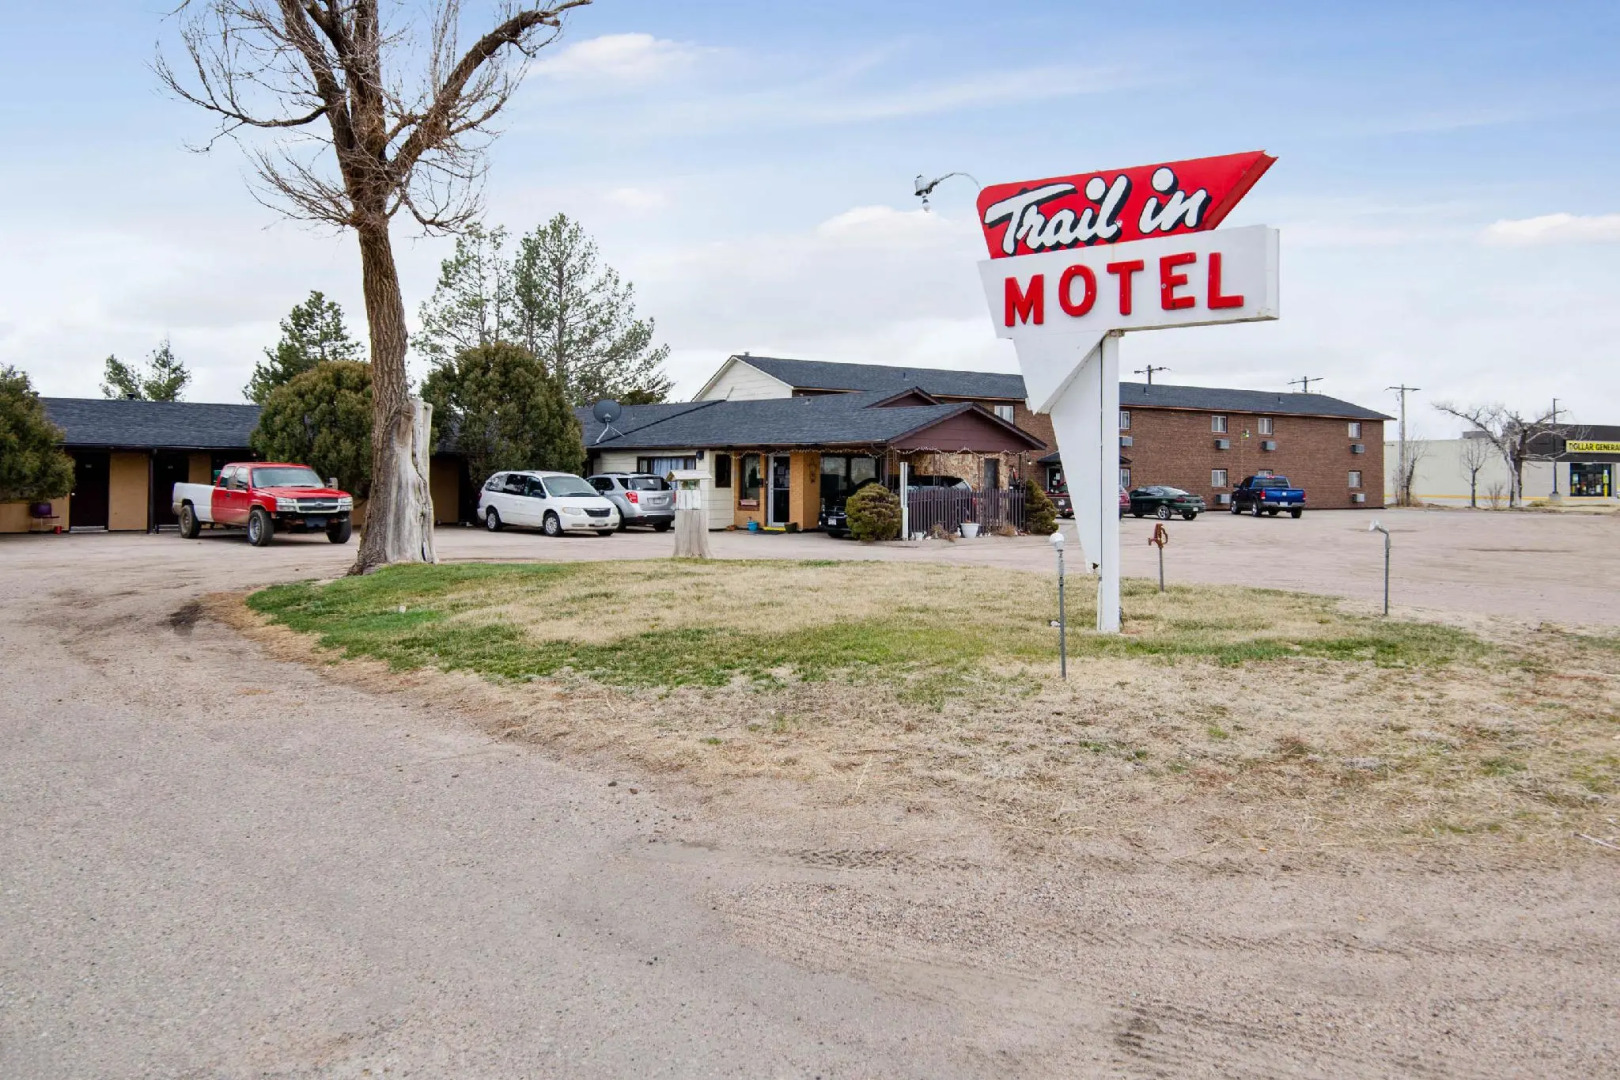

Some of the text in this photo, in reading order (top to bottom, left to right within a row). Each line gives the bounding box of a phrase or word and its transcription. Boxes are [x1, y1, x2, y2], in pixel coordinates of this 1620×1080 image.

[984, 166, 1211, 256] Trail in
[1004, 252, 1244, 327] MOTEL
[1595, 443, 1620, 451] GENERA
